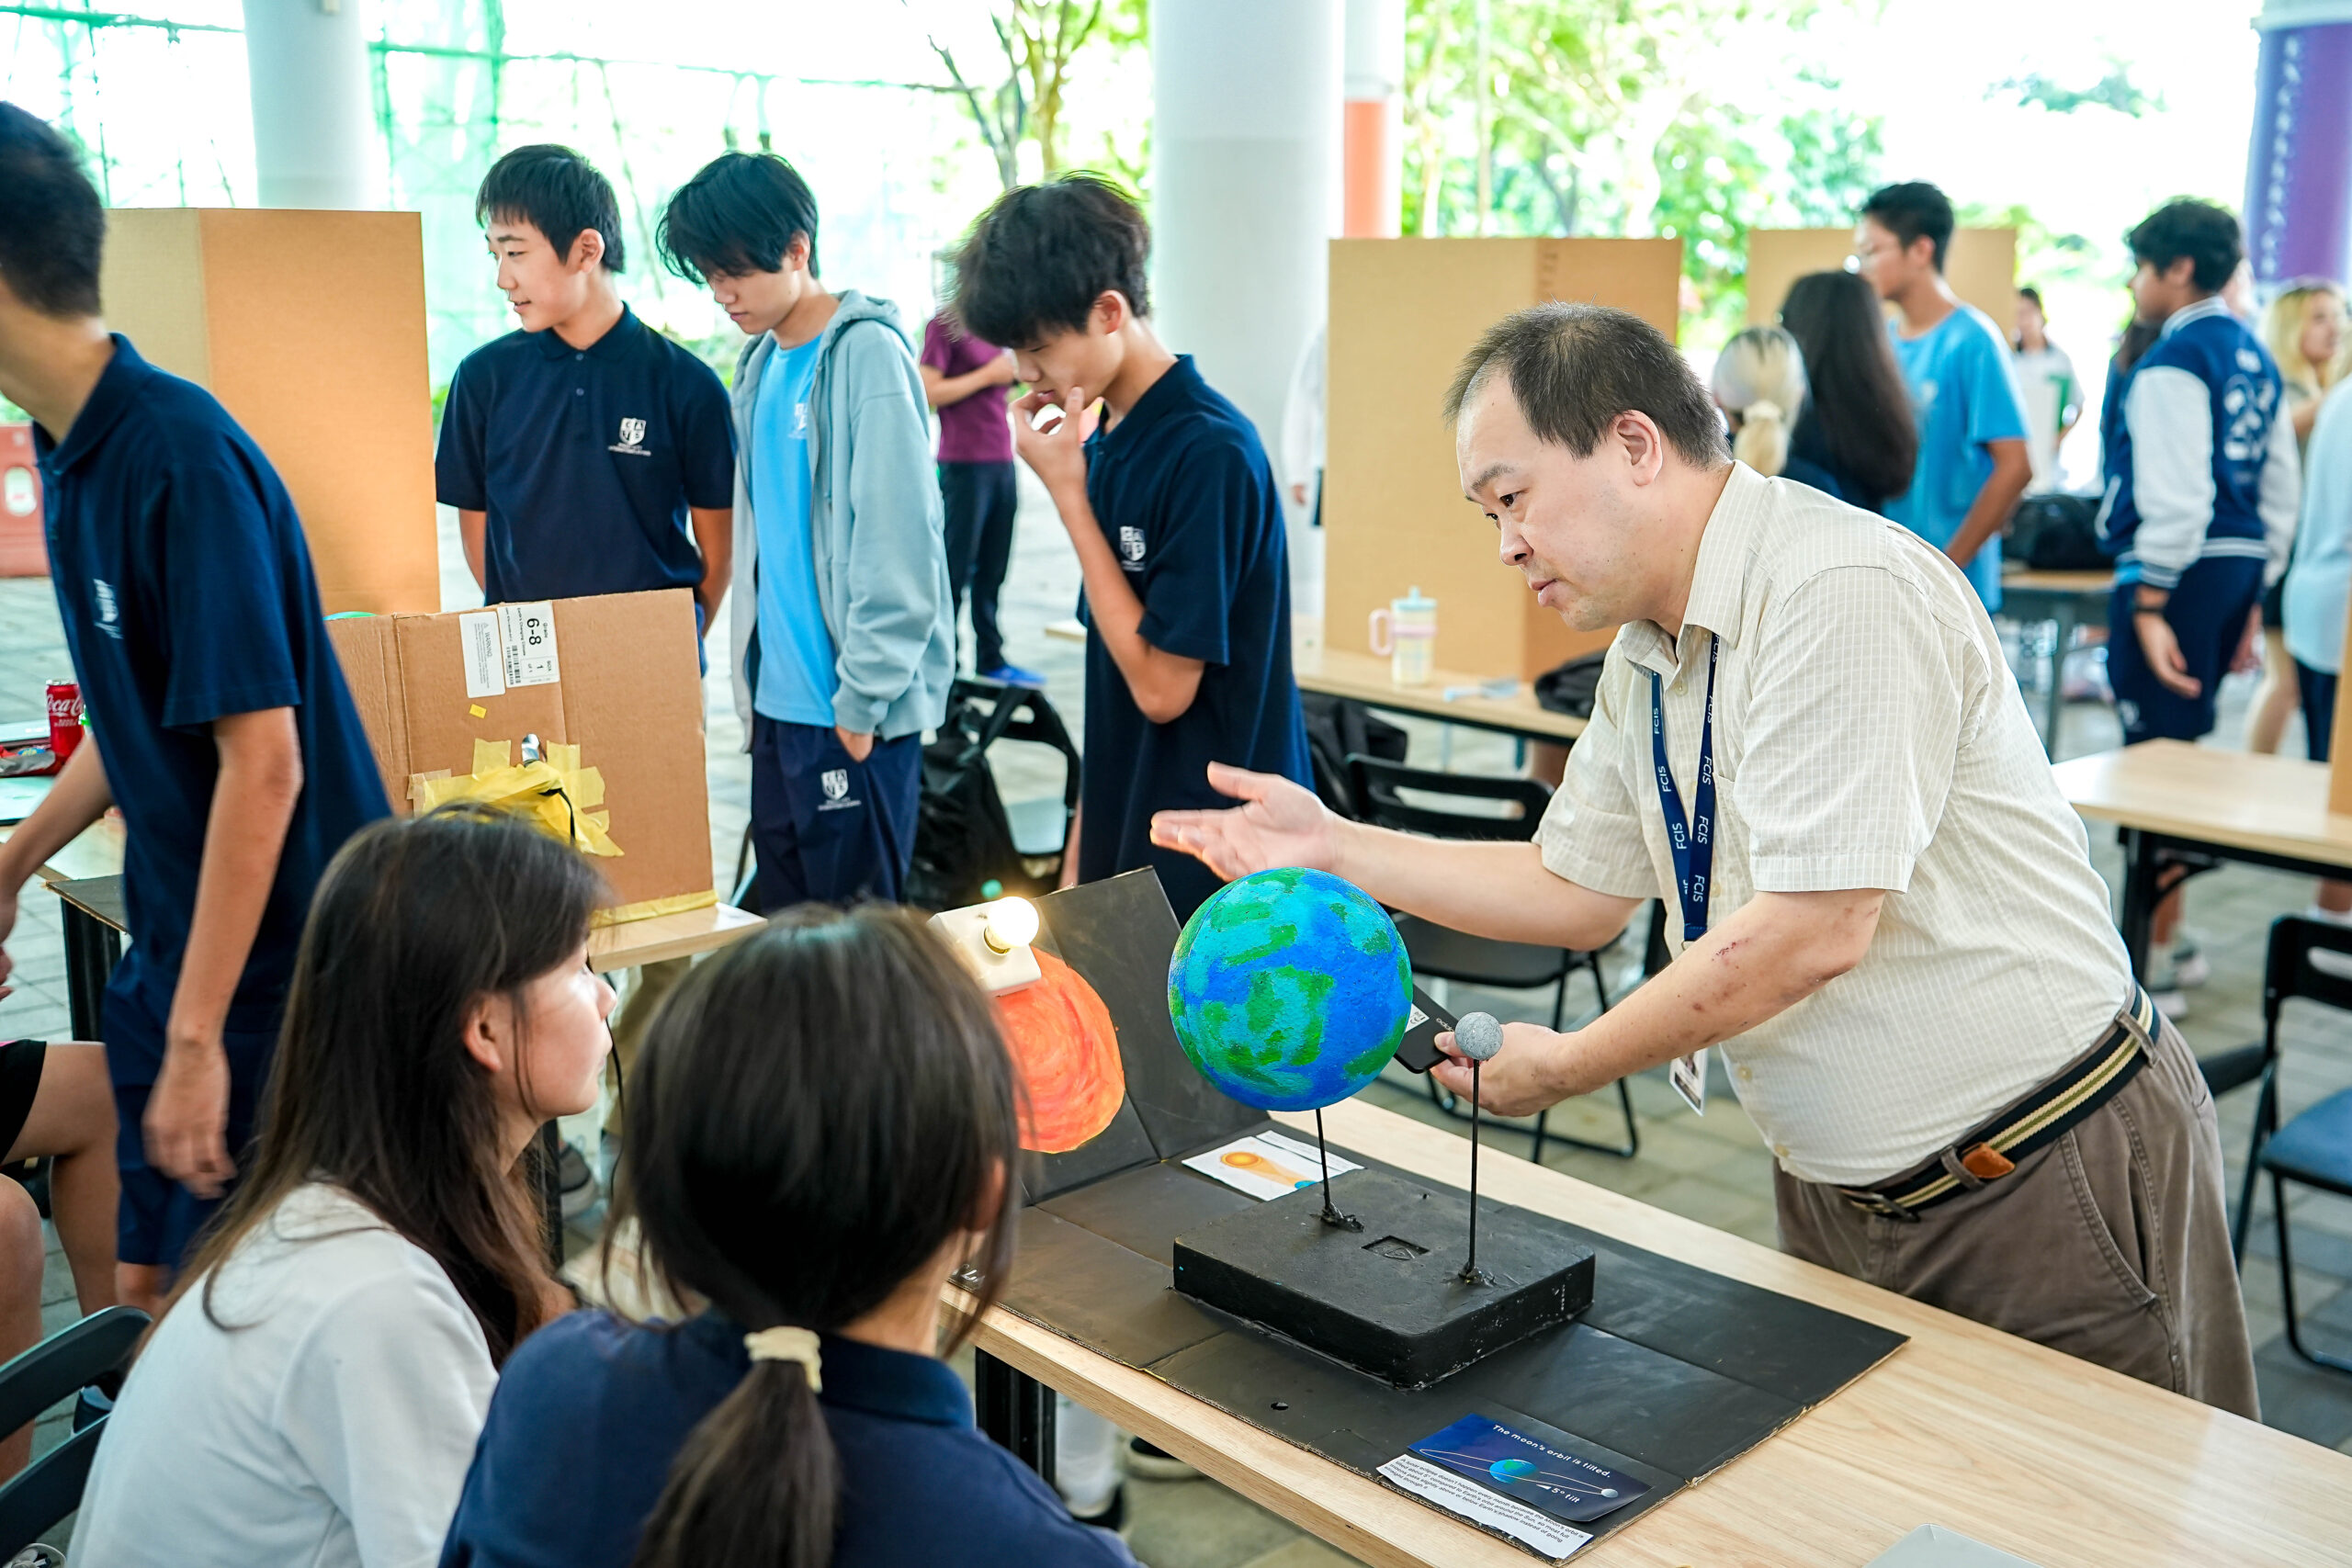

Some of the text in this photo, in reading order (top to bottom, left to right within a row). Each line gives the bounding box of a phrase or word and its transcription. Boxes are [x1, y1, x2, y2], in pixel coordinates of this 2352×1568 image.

[526, 618, 542, 646] 6-8
[1657, 765, 1672, 793] FCIS
[1702, 755, 1713, 785] FCIS
[1671, 822, 1687, 850] FCIS
[1697, 815, 1709, 845] FCIS
[1692, 874, 1705, 903] FCIS
[1492, 1424, 1510, 1435] The
[1510, 1433, 1545, 1450] moon's
[1546, 1450, 1572, 1462] orbit
[1582, 1461, 1611, 1478] tilted.
[1403, 1476, 1423, 1488] through
[1389, 1464, 1407, 1475] moons
[1420, 1478, 1439, 1489] slightly
[1439, 1486, 1455, 1495] above
[1463, 1496, 1478, 1506] below
[1479, 1503, 1498, 1513] Earth's
[1498, 1511, 1520, 1521] shadow
[1520, 1519, 1541, 1531] instead
[1546, 1531, 1563, 1543] going
[1408, 1468, 1423, 1476] about
[1430, 1477, 1456, 1489] compared
[1463, 1490, 1481, 1501] Earth's
[1494, 1505, 1514, 1514] around
[1523, 1515, 1535, 1524] Sun,
[1544, 1525, 1560, 1535] most
[1419, 1465, 1439, 1476] eclipse
[1457, 1482, 1478, 1494] happen
[1478, 1492, 1493, 1500] every
[1493, 1498, 1510, 1507] month
[1510, 1505, 1534, 1516] because
[1544, 1517, 1565, 1530] Moon's
[1565, 1527, 1579, 1537] orbit
[1565, 1493, 1580, 1504] tilt
